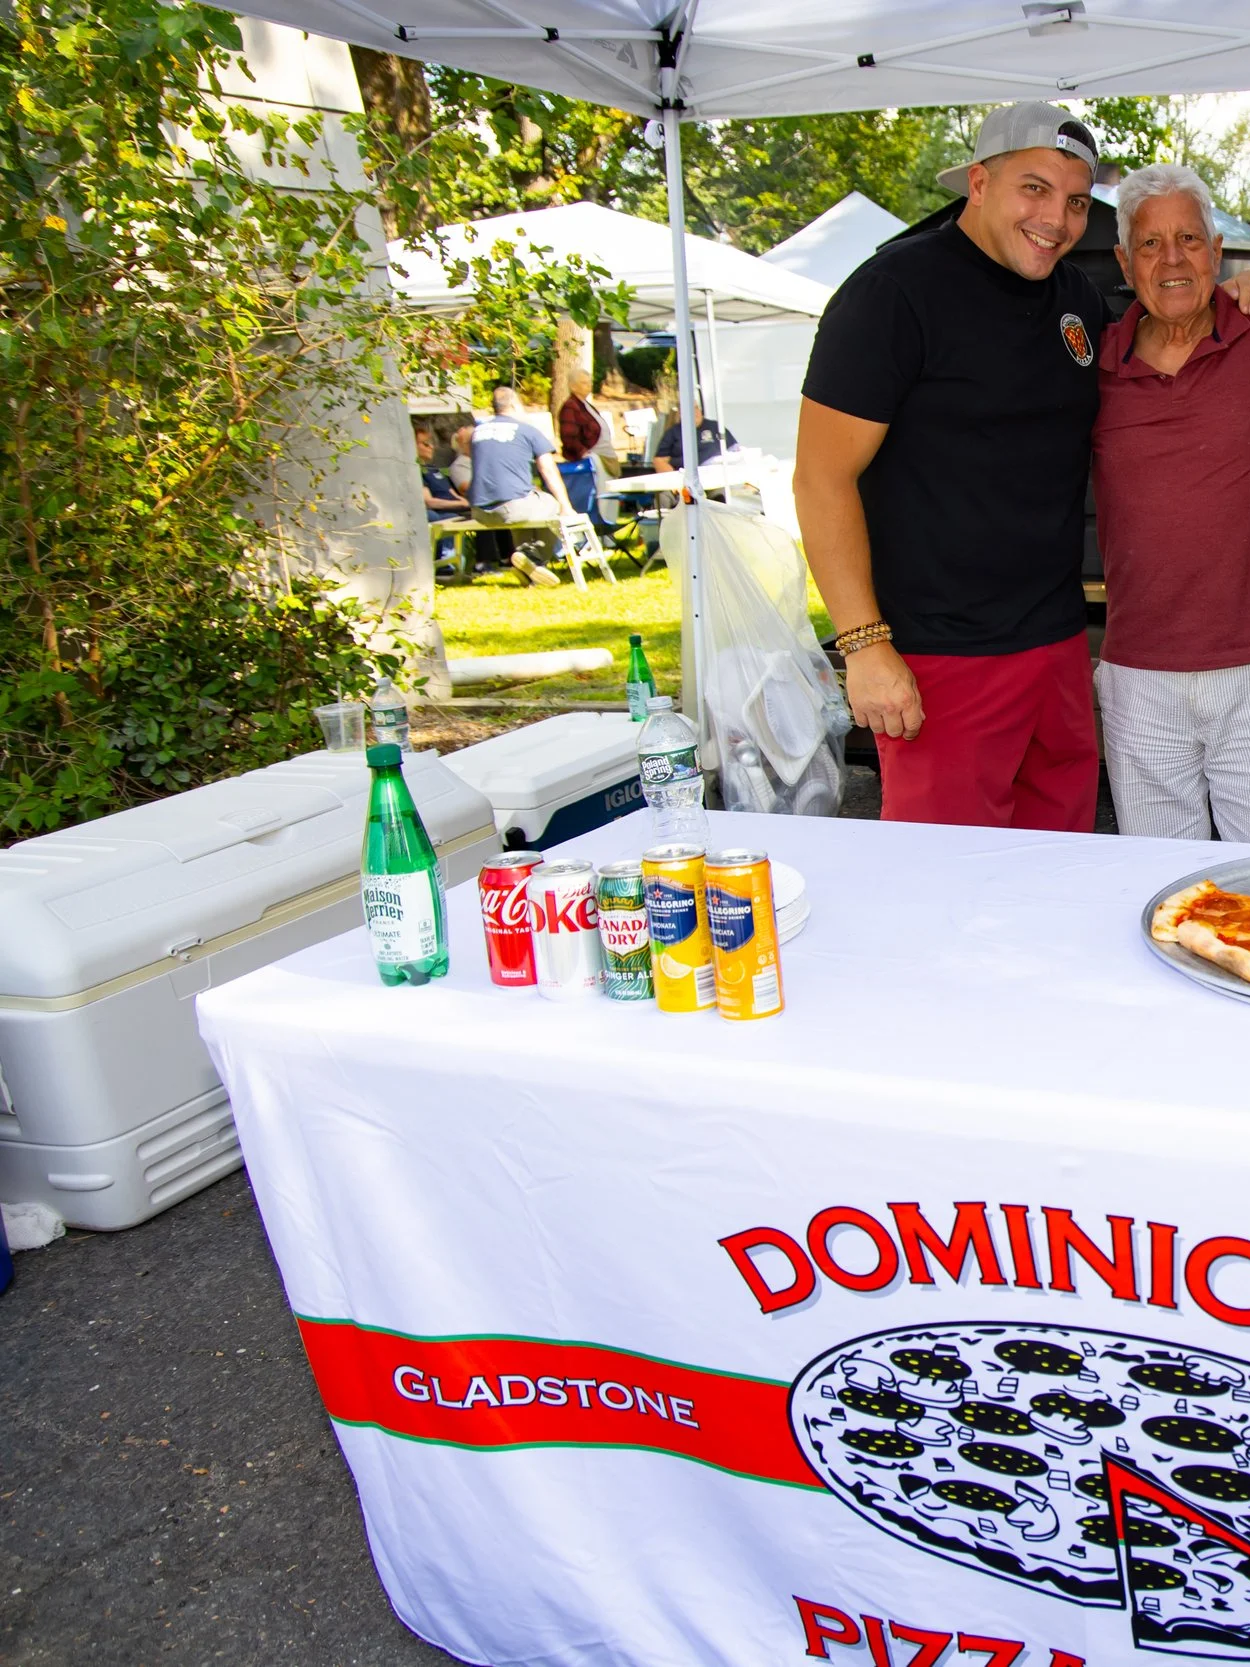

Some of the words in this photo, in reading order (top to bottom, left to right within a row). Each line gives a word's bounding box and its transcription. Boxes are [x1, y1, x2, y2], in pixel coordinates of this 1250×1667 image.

[641, 755, 669, 771] Poland
[644, 765, 674, 781] Spring
[604, 781, 643, 812] IGLO
[529, 890, 599, 934] oke
[607, 933, 629, 946] DRY
[605, 970, 635, 981] GINGER
[393, 1364, 700, 1430] GLADSTONE
